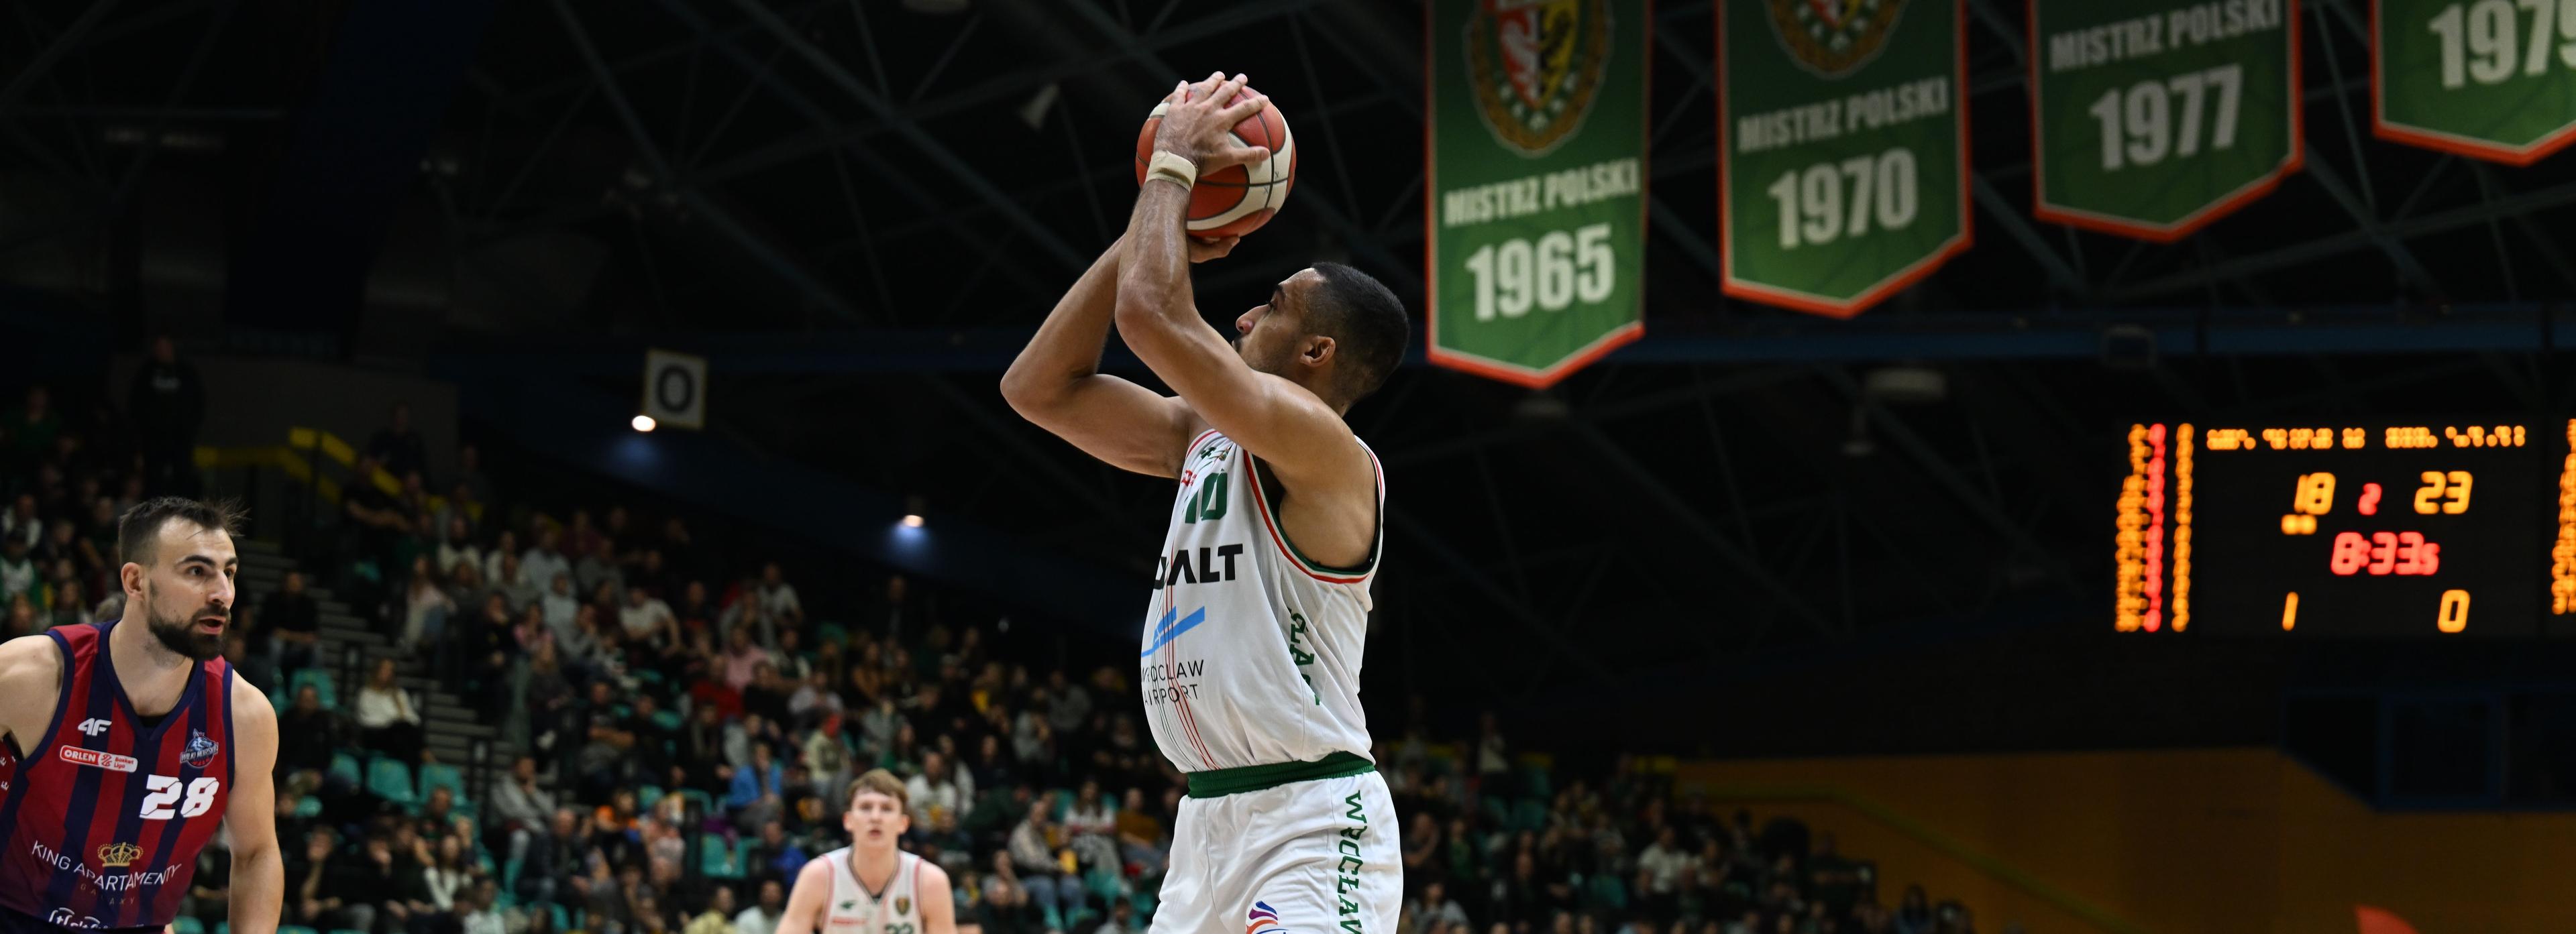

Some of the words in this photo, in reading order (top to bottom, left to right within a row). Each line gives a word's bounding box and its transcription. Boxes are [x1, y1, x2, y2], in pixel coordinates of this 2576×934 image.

[2051, 15, 2162, 71] MISTRZ
[2169, 0, 2280, 48] POLSKI
[1738, 101, 1841, 154] MISTRZ
[1847, 76, 1949, 131] POLSKI
[2089, 65, 2243, 171] 1977
[1444, 176, 1540, 227] MISTRZ
[1545, 158, 1639, 209] POLSKI
[1768, 148, 1917, 249] 1970
[1465, 223, 1615, 320] 1965
[2294, 472, 2336, 515] 18
[2414, 471, 2473, 514] 23
[2438, 589, 2470, 633] 0
[1144, 684, 1197, 706] AIRPORT
[78, 717, 112, 736] 4F
[64, 750, 96, 762] ORLEN
[140, 774, 219, 820] 28
[32, 840, 71, 870] KING
[74, 862, 182, 892] APARTAMENTY
[80, 883, 135, 906] GAAXY
